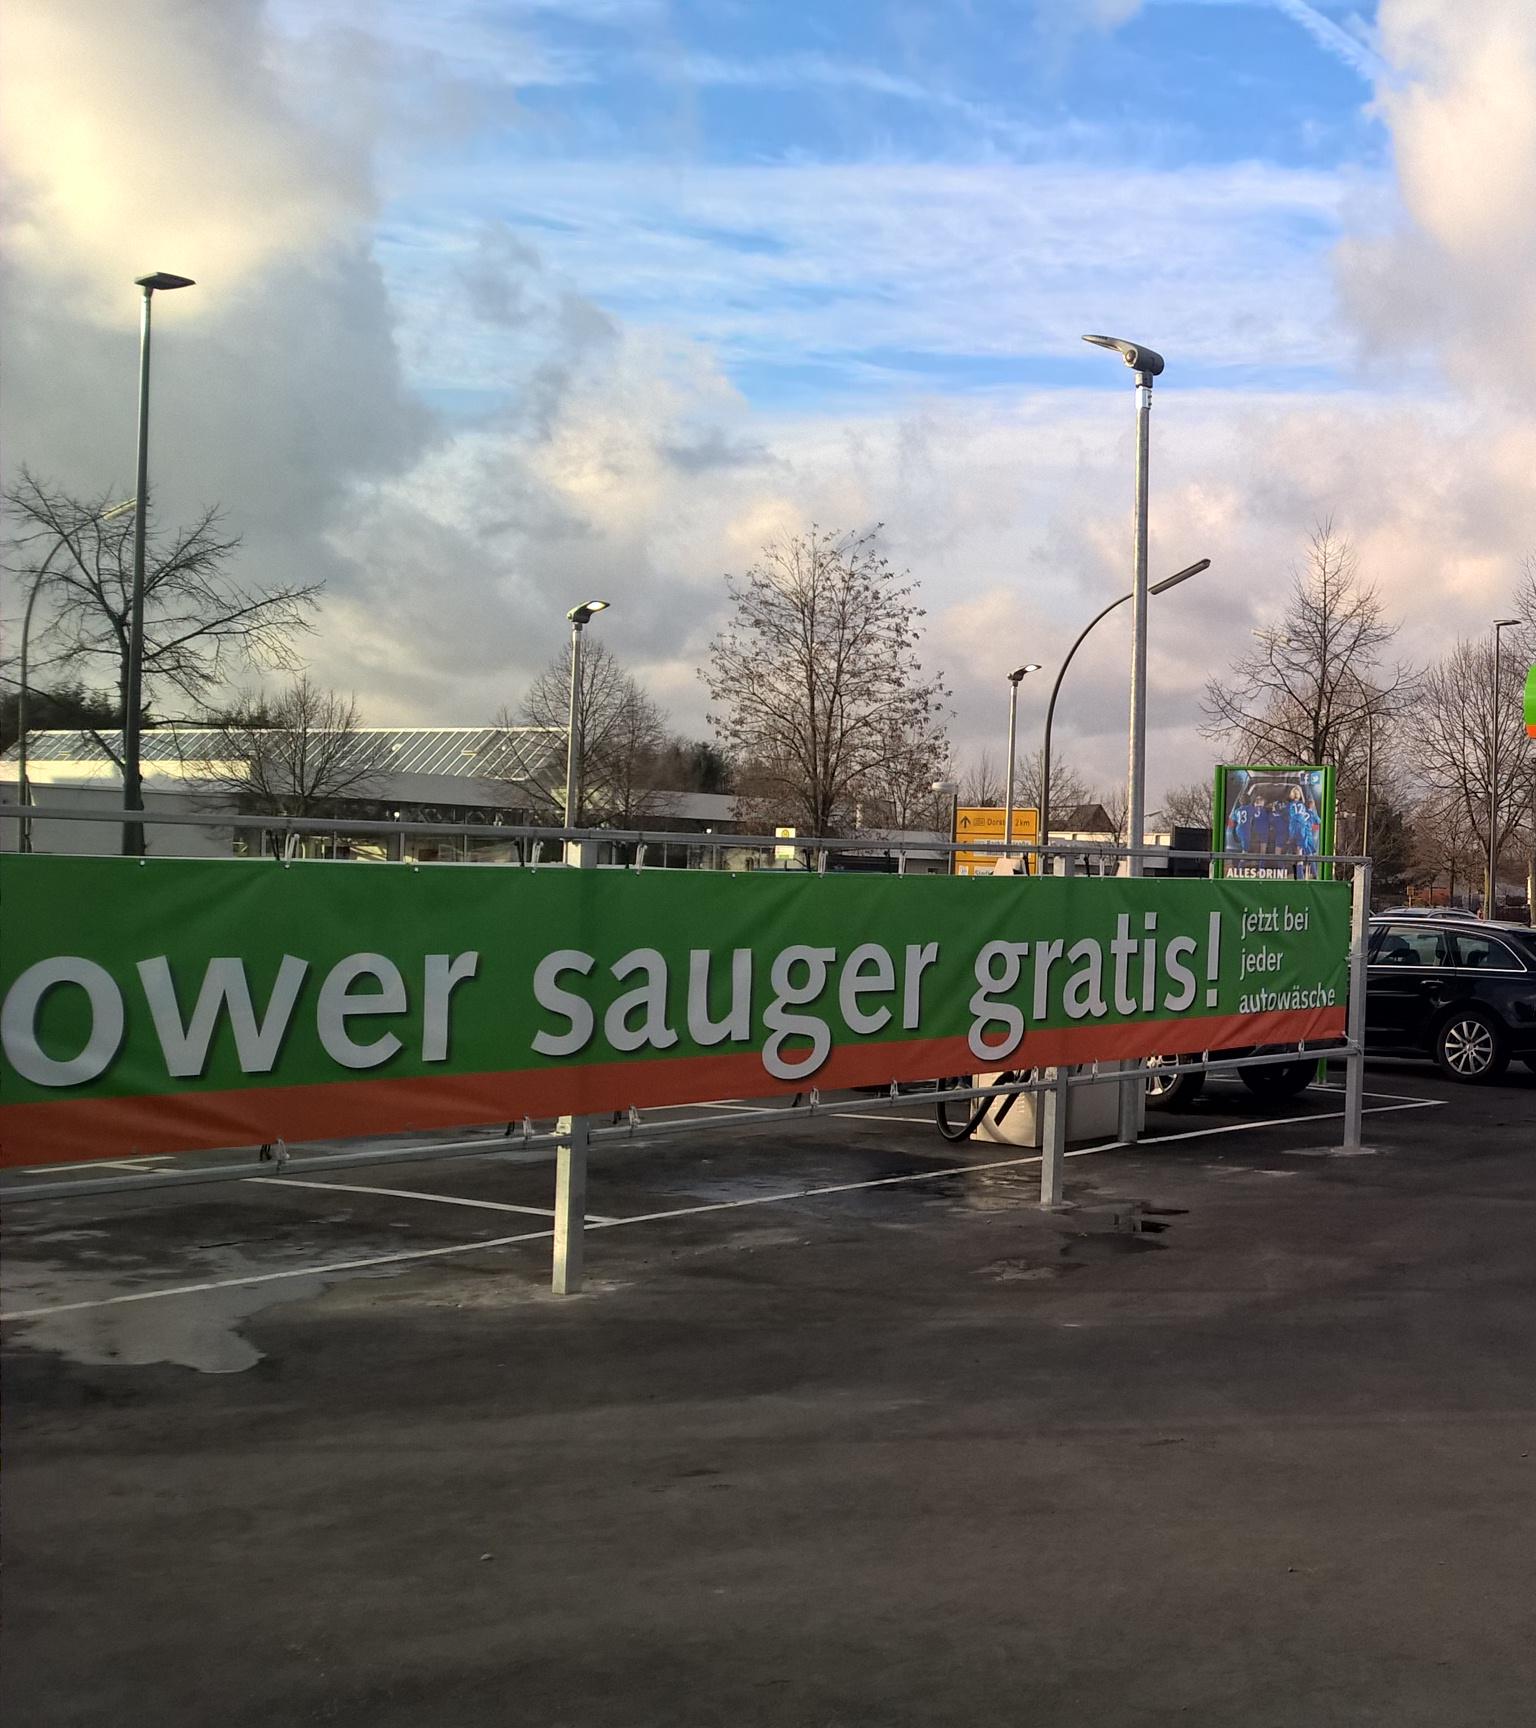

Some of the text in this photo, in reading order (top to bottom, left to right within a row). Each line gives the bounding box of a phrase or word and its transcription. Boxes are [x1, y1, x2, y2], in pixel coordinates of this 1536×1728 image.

[1226, 868, 1288, 879] ALLES DRIN!
[1241, 904, 1309, 940] jetzt bei
[1240, 945, 1283, 981] jeder
[0, 911, 1222, 1087] ower sauger gratis!
[1239, 982, 1336, 1014] autowäsche
